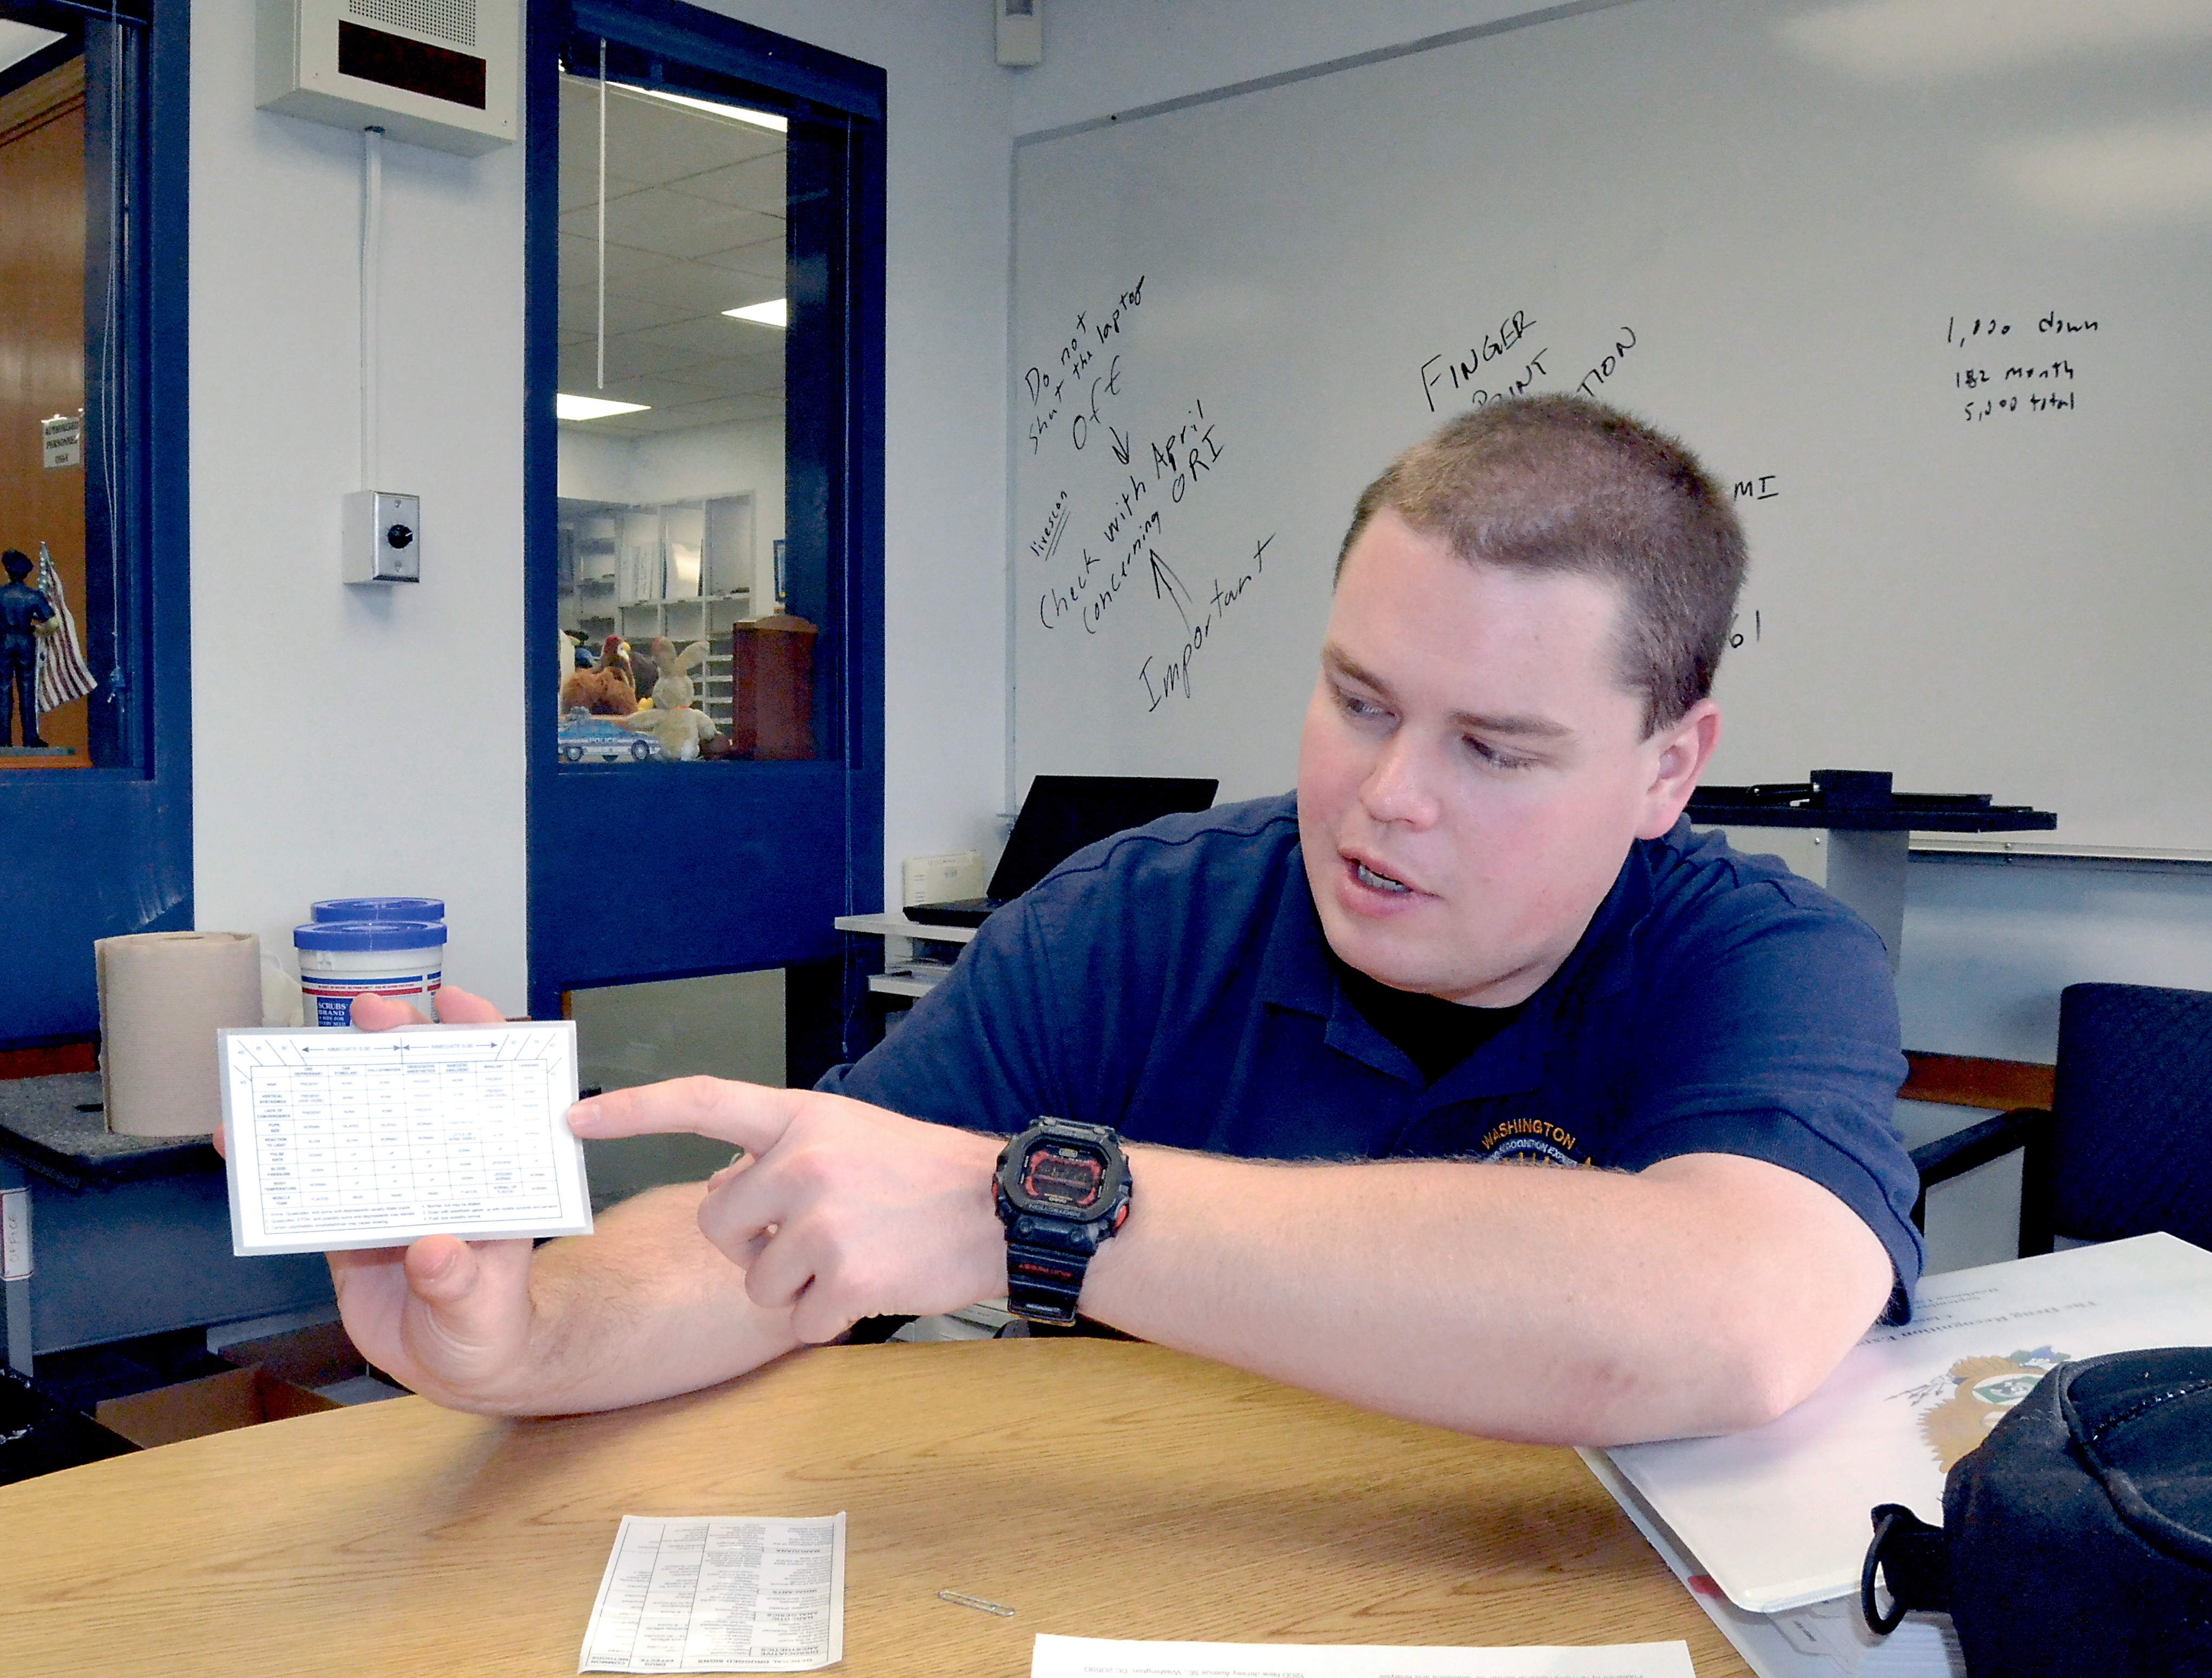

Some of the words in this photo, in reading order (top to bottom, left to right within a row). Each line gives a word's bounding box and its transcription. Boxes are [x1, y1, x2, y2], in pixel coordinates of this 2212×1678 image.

[1096, 275, 1145, 344] laptop
[1025, 367, 1049, 406] Do
[1061, 310, 1087, 365] not
[1422, 310, 1536, 411] FINGER
[1172, 424, 1225, 503] ORI
[1040, 548, 1101, 629] Check
[1104, 475, 1147, 542] with
[1151, 399, 1204, 480] April
[1139, 533, 1276, 712] Important
[1481, 1118, 1576, 1150] WASHINGTON
